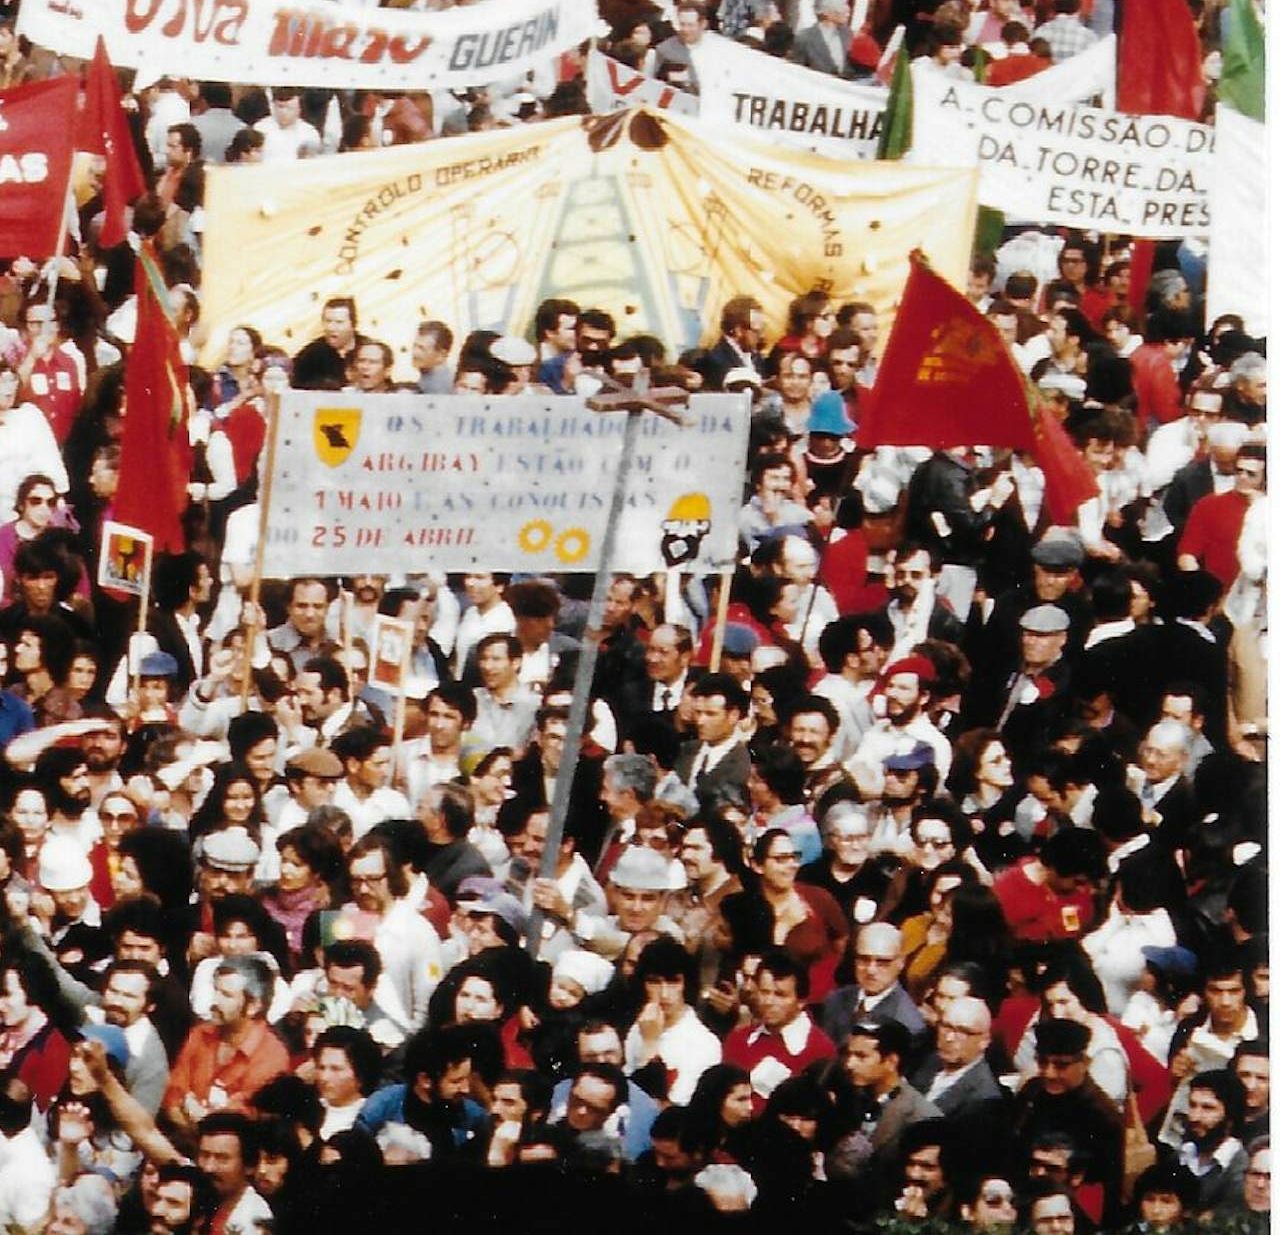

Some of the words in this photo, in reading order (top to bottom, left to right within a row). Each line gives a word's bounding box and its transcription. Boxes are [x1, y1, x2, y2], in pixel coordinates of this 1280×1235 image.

[448, 4, 560, 73] GUERIN
[977, 134, 1017, 167] DA
[1038, 146, 1143, 189] TORRE
[1155, 168, 1199, 194] DA
[1047, 186, 1121, 221] ESTA
[338, 491, 402, 511] MAIO
[312, 526, 347, 547] 25
[357, 528, 383, 547] DE
[404, 528, 475, 546] ABRIL
